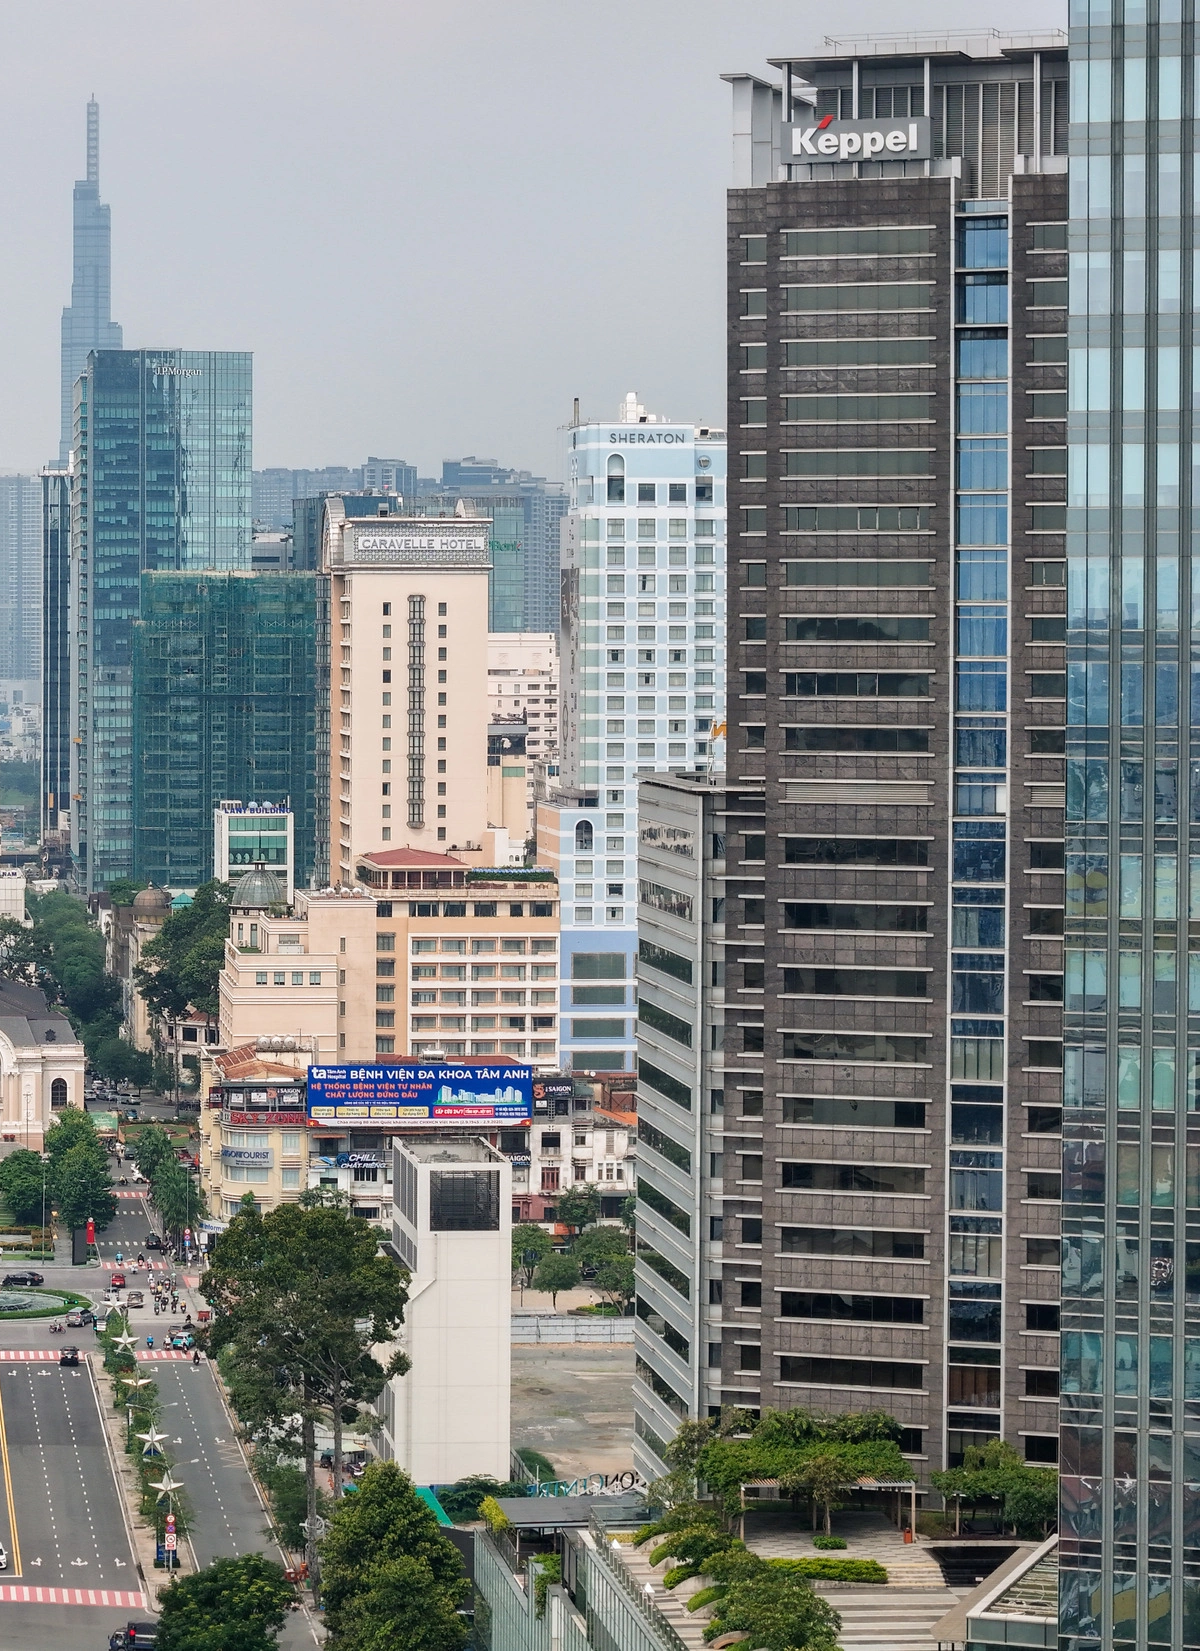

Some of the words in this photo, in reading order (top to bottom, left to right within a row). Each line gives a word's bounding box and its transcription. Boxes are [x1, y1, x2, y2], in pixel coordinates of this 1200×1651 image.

[792, 114, 918, 160] Keppel
[609, 433, 685, 444] SHERATON
[362, 539, 435, 550] CARAVELLE
[440, 539, 481, 550] HOTEL
[311, 1067, 326, 1079] ta
[350, 1068, 383, 1082] BỆNH
[386, 1068, 415, 1082] VIỆN
[418, 1070, 435, 1079] ĐA
[439, 1070, 472, 1079] KHOA
[475, 1067, 499, 1079] TÂM
[503, 1070, 529, 1079] ANH
[311, 1082, 322, 1091] HỆ
[353, 1082, 375, 1091] BỆNH
[377, 1082, 395, 1091] VIỆN
[231, 1112, 258, 1124] SKY
[265, 1112, 306, 1124] ZONE
[349, 1154, 377, 1162] CHILL
